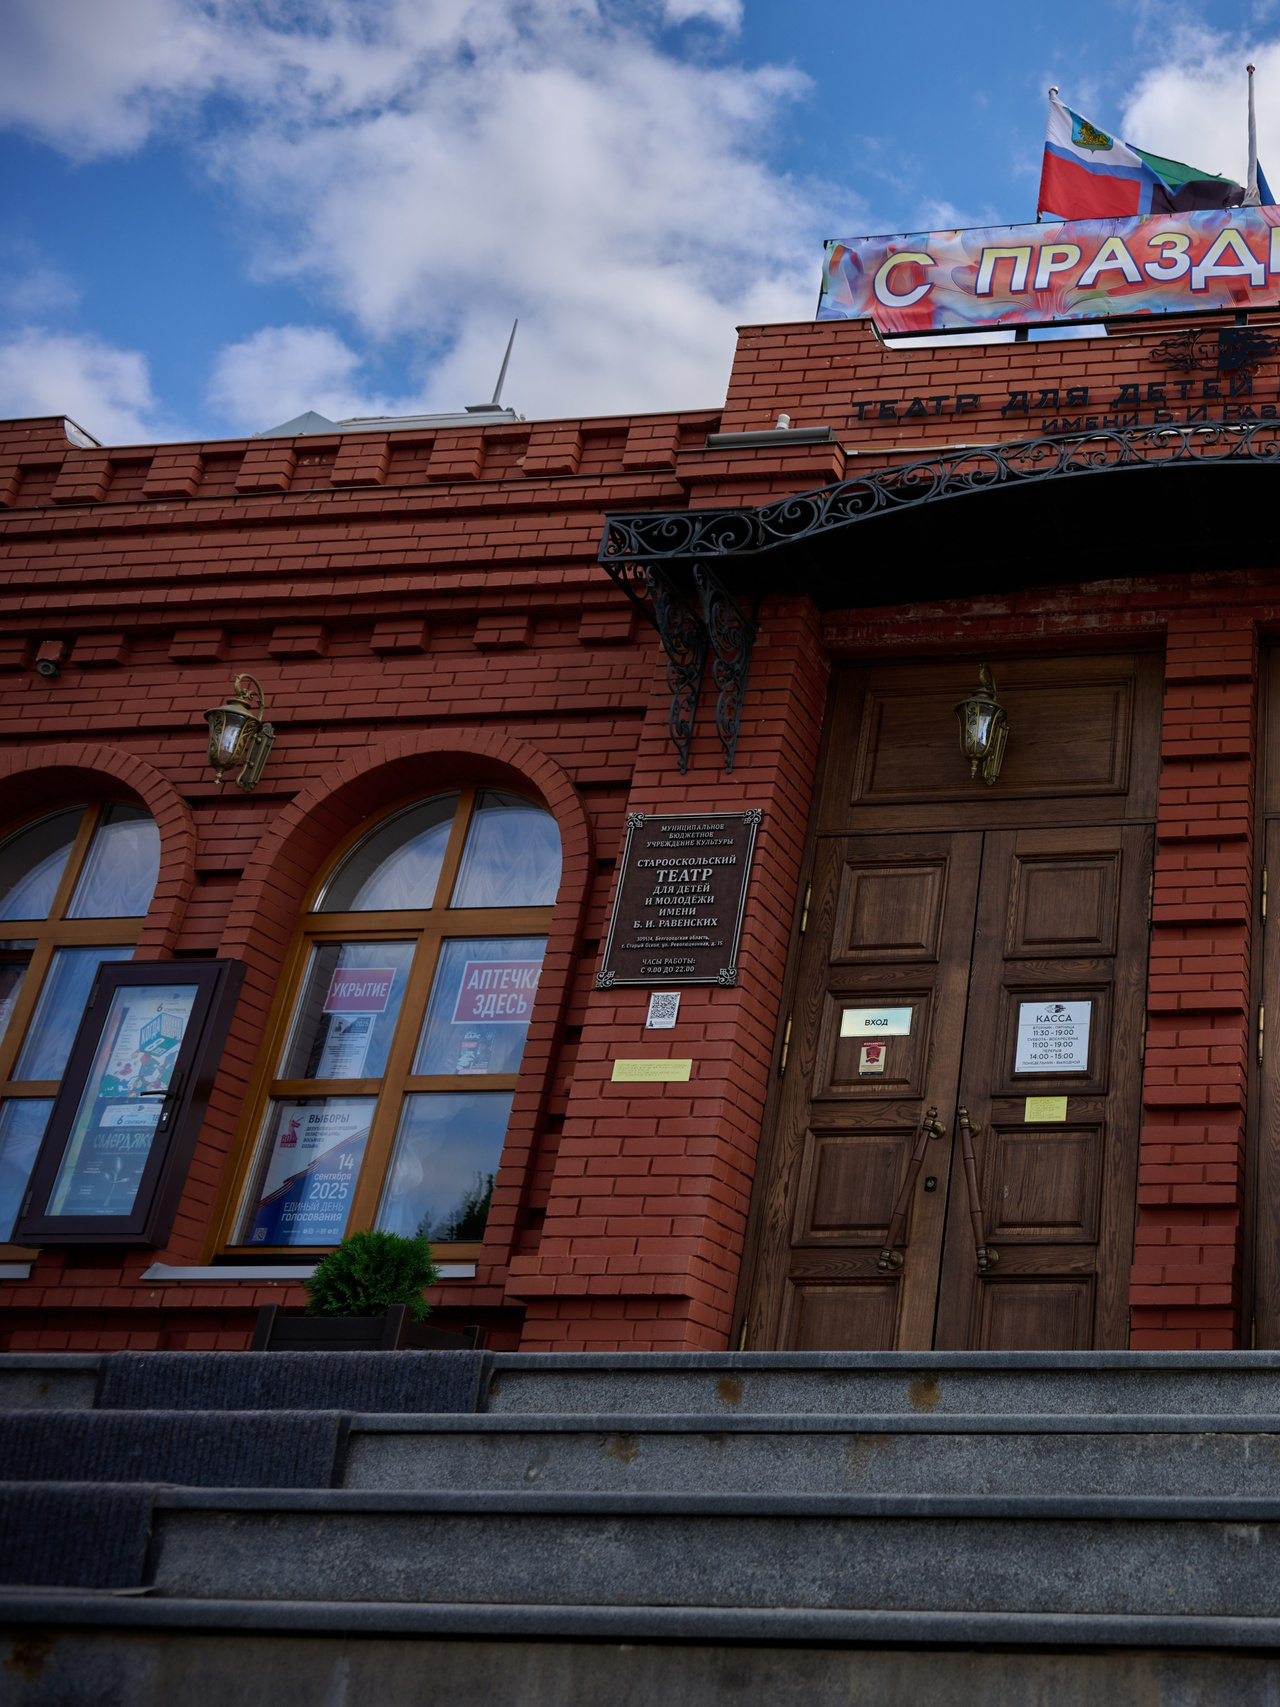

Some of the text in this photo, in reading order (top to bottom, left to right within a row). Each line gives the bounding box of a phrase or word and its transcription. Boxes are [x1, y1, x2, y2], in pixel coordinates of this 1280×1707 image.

[873, 250, 936, 309] С
[852, 394, 979, 421] ТЕАТР
[1001, 386, 1088, 415] ДЛЯ
[1112, 371, 1252, 408] ДЕТЕЙ
[1041, 413, 1140, 432] ИМЕНИ
[661, 824, 726, 833] МУНИЦИПАЛЬНОЕ
[669, 832, 714, 840] БЮДЖЕТНОЕ
[646, 839, 734, 848] УЧРЕЖДЕНИЕ КУЛЬТУРЫ
[637, 855, 737, 868] СТАРООСКОЛЬСКИЙ
[657, 868, 713, 883] ТЕАТР
[653, 883, 710, 896] ДЛЯ ДЕТЕЙ
[645, 895, 715, 906] И МОЛОДЁЖИ
[659, 907, 696, 916] ИМЕНИ
[633, 918, 718, 929] Б. И. РАВЕНСКИХ
[663, 957, 696, 965] РАБОТЫ:
[662, 966, 673, 974] ДО
[674, 965, 695, 973] 22.00
[332, 982, 389, 998] УКРЫТИЕ
[157, 1002, 164, 1013] 6
[472, 993, 527, 1018] ЗДЕСЬ
[864, 1019, 889, 1027] ВХОД
[1035, 1014, 1073, 1023] КАССА
[144, 1037, 165, 1052] 8
[117, 1115, 124, 1125] 6
[308, 1114, 350, 1124] ВЫБОРЫ
[339, 1153, 354, 1170] 14
[314, 1171, 352, 1182] сентября
[310, 1182, 350, 1200] 2025
[284, 1201, 344, 1212] ЕДИНЫЙ ДЕНЬ
